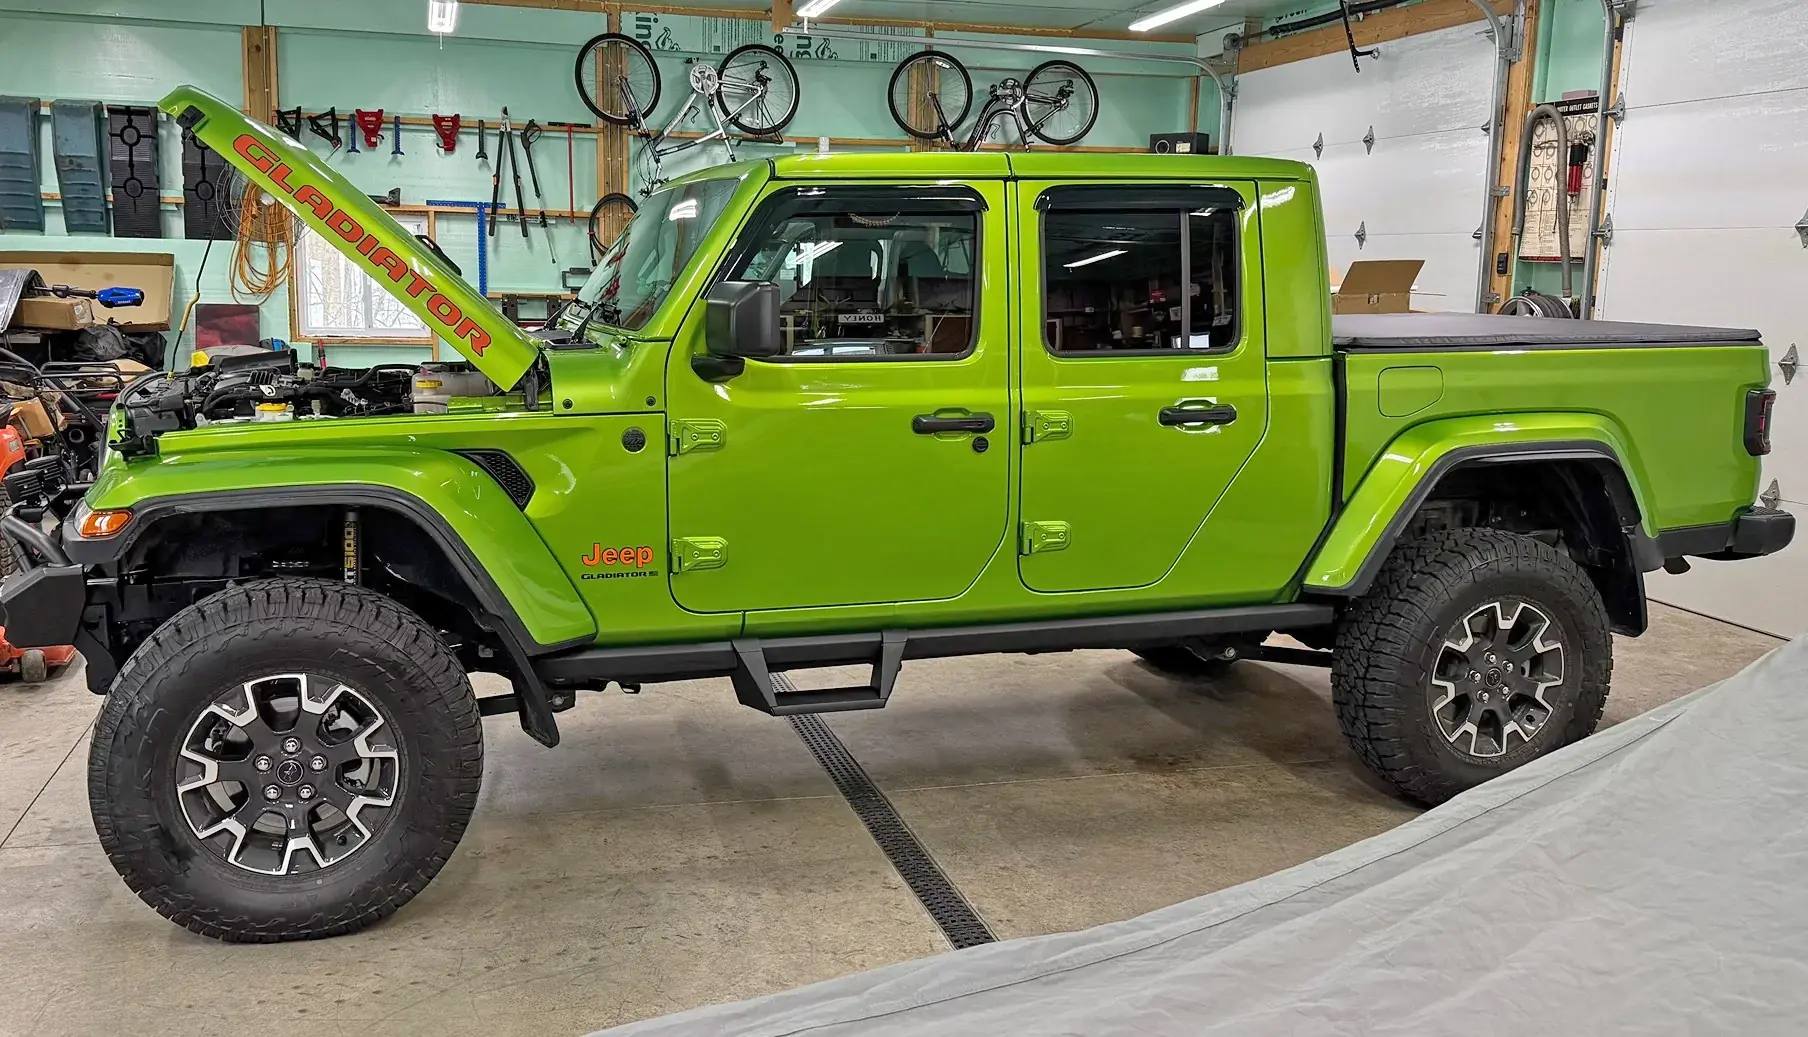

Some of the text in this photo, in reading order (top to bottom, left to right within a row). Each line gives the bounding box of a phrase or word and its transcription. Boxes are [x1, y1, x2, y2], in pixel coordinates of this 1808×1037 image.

[1569, 103, 1582, 112] OUTLET
[1583, 101, 1598, 110] GASKETS
[233, 134, 491, 357] GLADIATOR
[582, 543, 654, 568] Jeep
[581, 571, 647, 580] GLADIATOR
